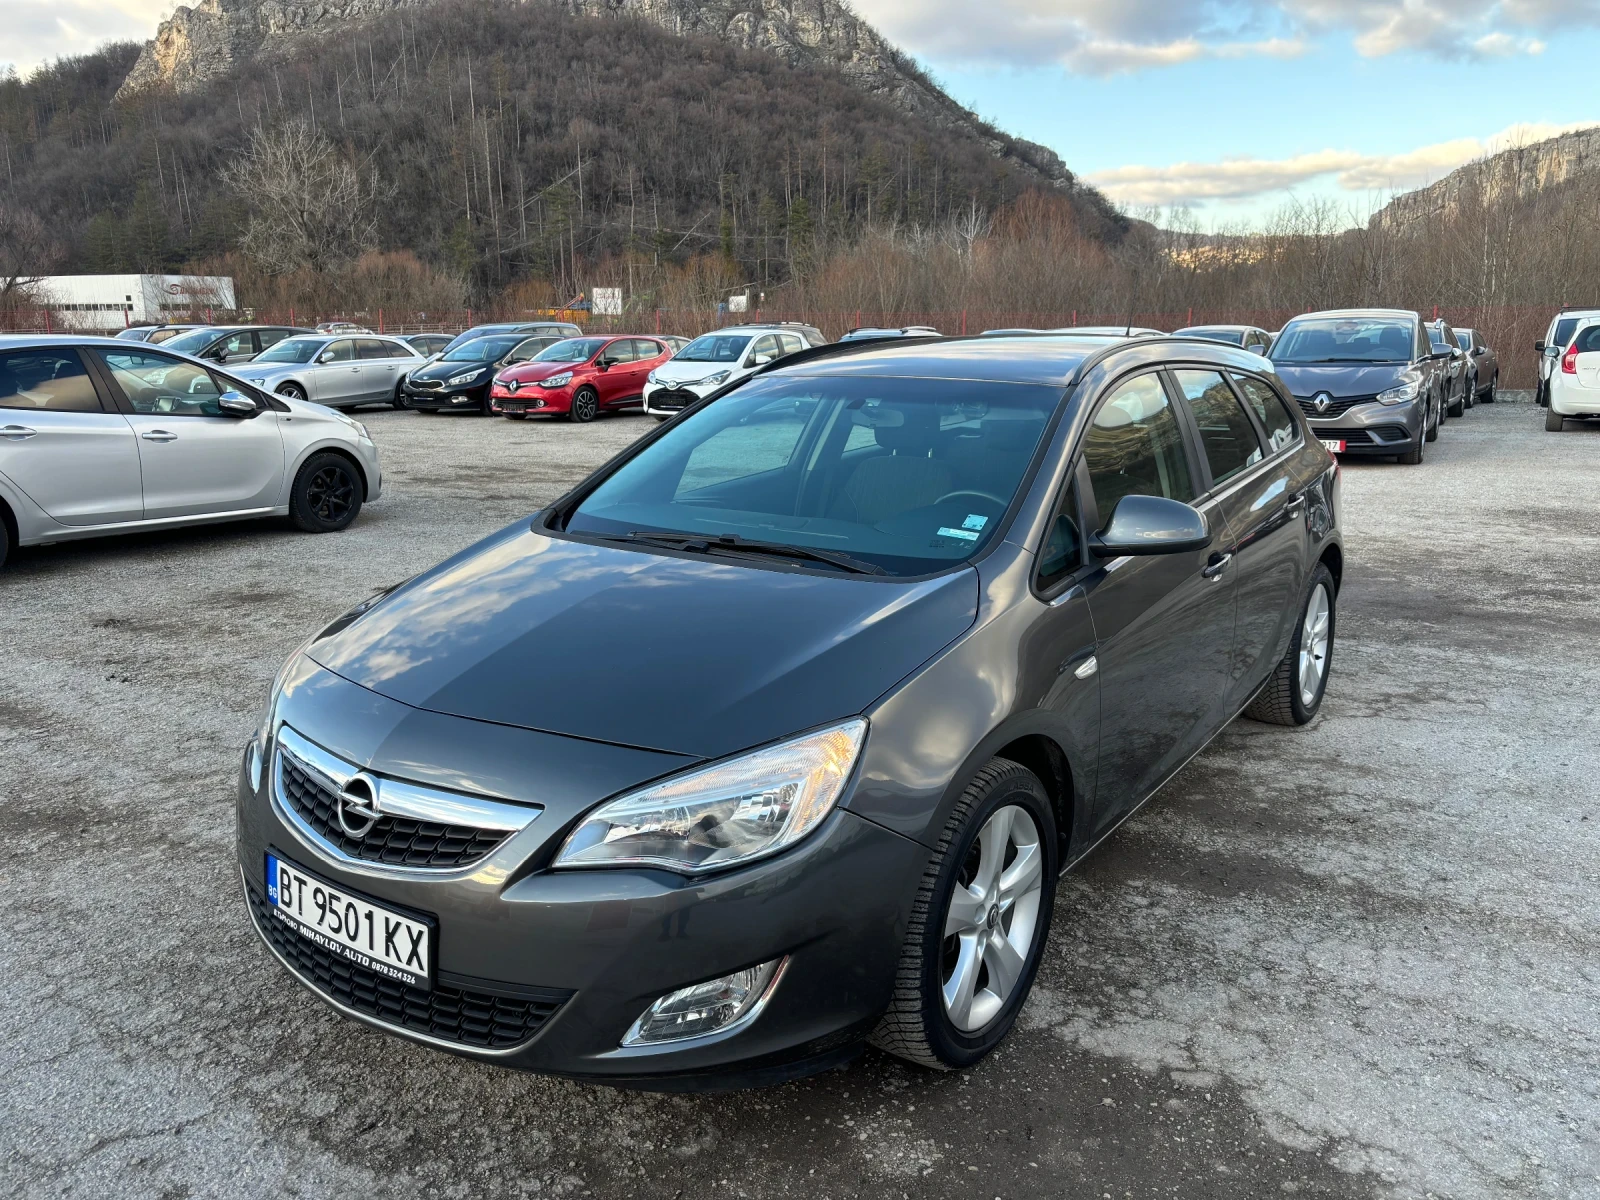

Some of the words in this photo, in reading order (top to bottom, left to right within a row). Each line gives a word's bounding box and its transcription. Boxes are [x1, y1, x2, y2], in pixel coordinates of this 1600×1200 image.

[268, 884, 277, 899] BG
[280, 866, 307, 916] BT
[313, 887, 374, 952] 9501
[384, 916, 425, 972] KX
[299, 925, 343, 953] MIHAYLOV
[343, 948, 370, 966] AUTO
